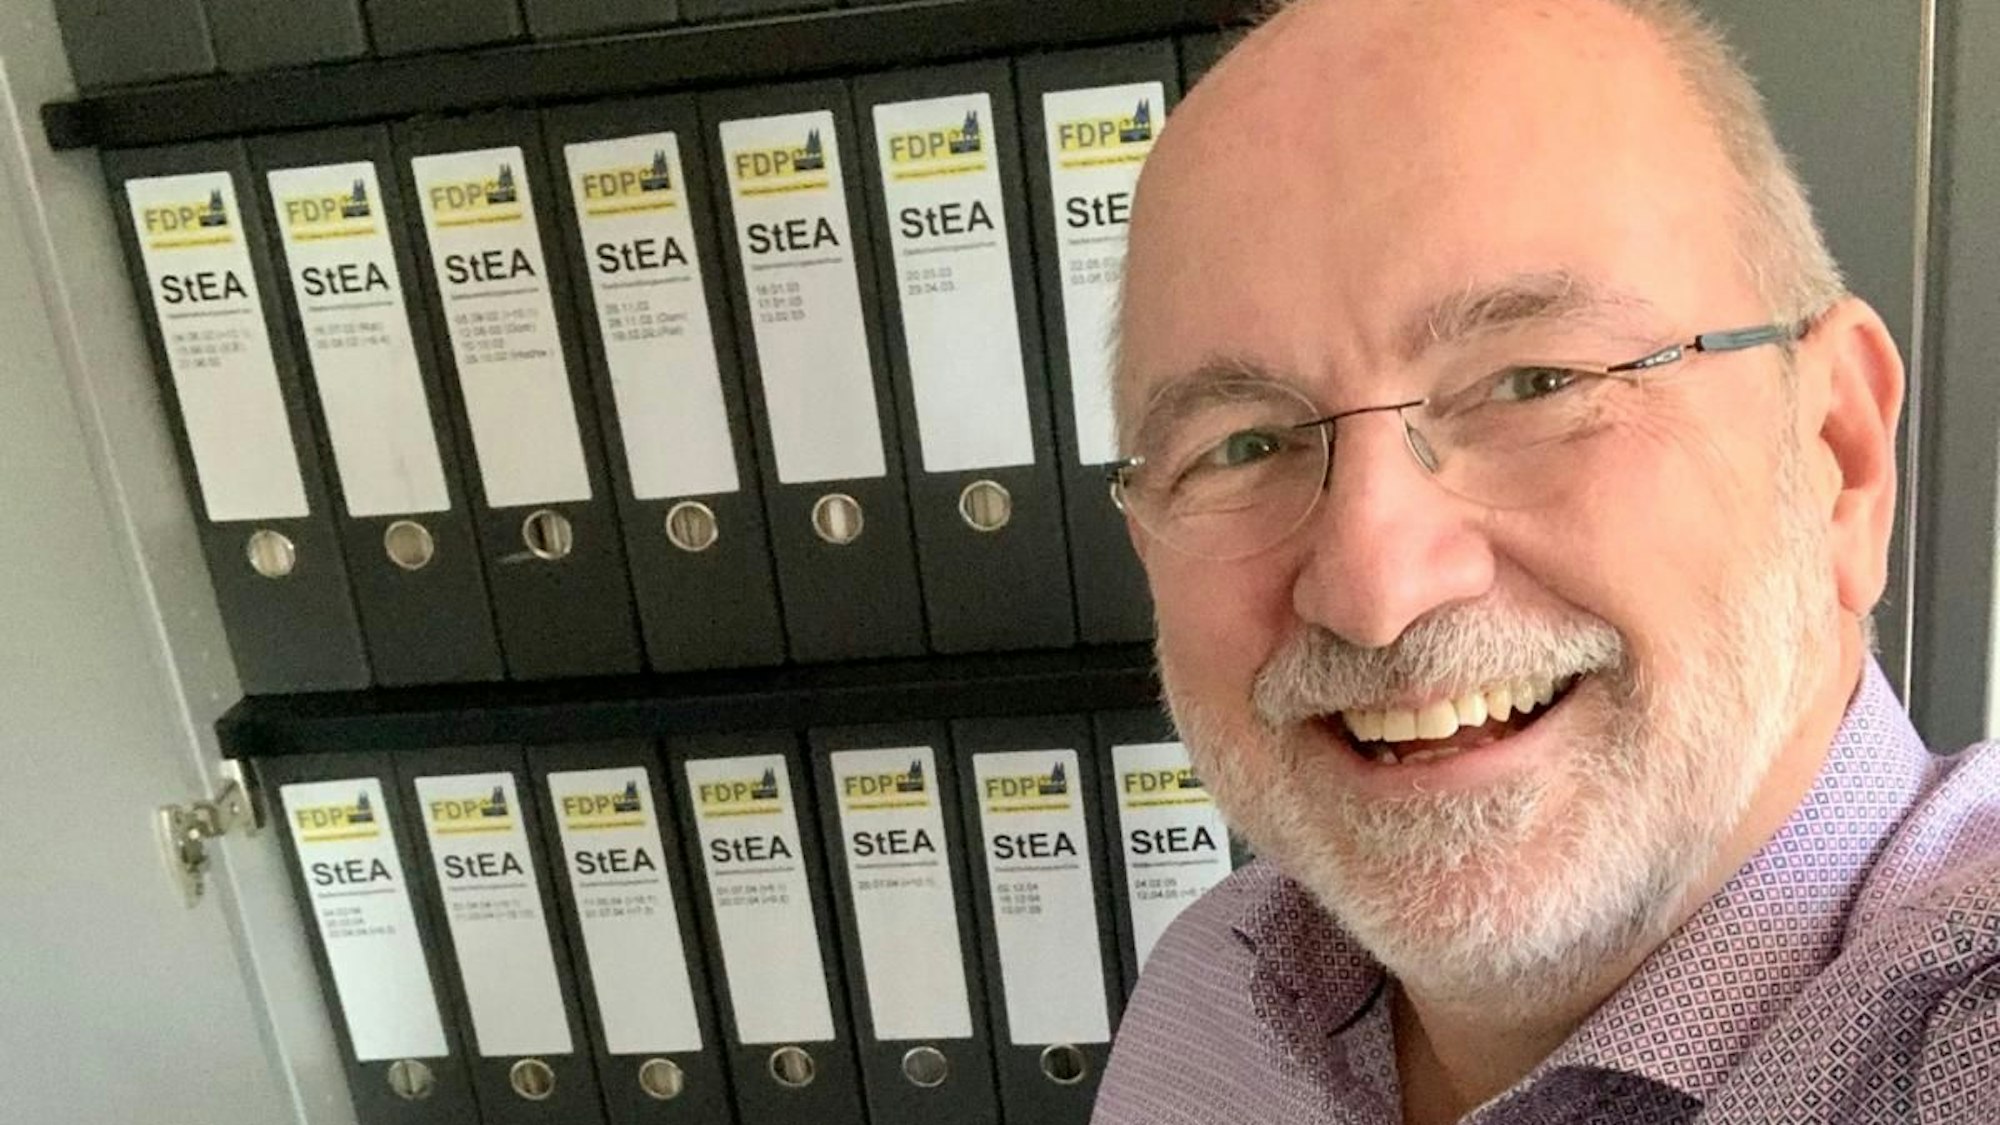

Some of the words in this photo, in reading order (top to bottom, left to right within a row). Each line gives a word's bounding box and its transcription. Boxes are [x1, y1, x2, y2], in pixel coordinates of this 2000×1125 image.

[890, 132, 944, 160] FDP
[1058, 122, 1115, 149] FDP
[735, 150, 790, 178] FDP
[430, 183, 482, 210] FDP
[582, 171, 635, 199] FDP
[144, 206, 194, 232] FDP
[284, 198, 336, 224] FDP
[900, 201, 994, 238] StEA
[1066, 193, 1130, 228] StE
[748, 218, 839, 254] StEA
[446, 248, 536, 284] StEA
[597, 237, 687, 274] StEA
[160, 270, 248, 304] StEA
[302, 262, 390, 296] StEA
[700, 782, 748, 803] FDP
[844, 774, 893, 796] FDP
[986, 777, 1035, 798] FDP
[1124, 772, 1175, 794] FDP
[296, 808, 343, 829] FDP
[430, 800, 478, 820] FDP
[562, 795, 611, 816] FDP
[711, 835, 791, 862] StEA
[853, 828, 935, 857] StEA
[994, 832, 1076, 859] StEA
[1131, 826, 1216, 854] StEA
[312, 858, 392, 886] StEA
[444, 852, 523, 878] StEA
[575, 848, 655, 874] StEA
